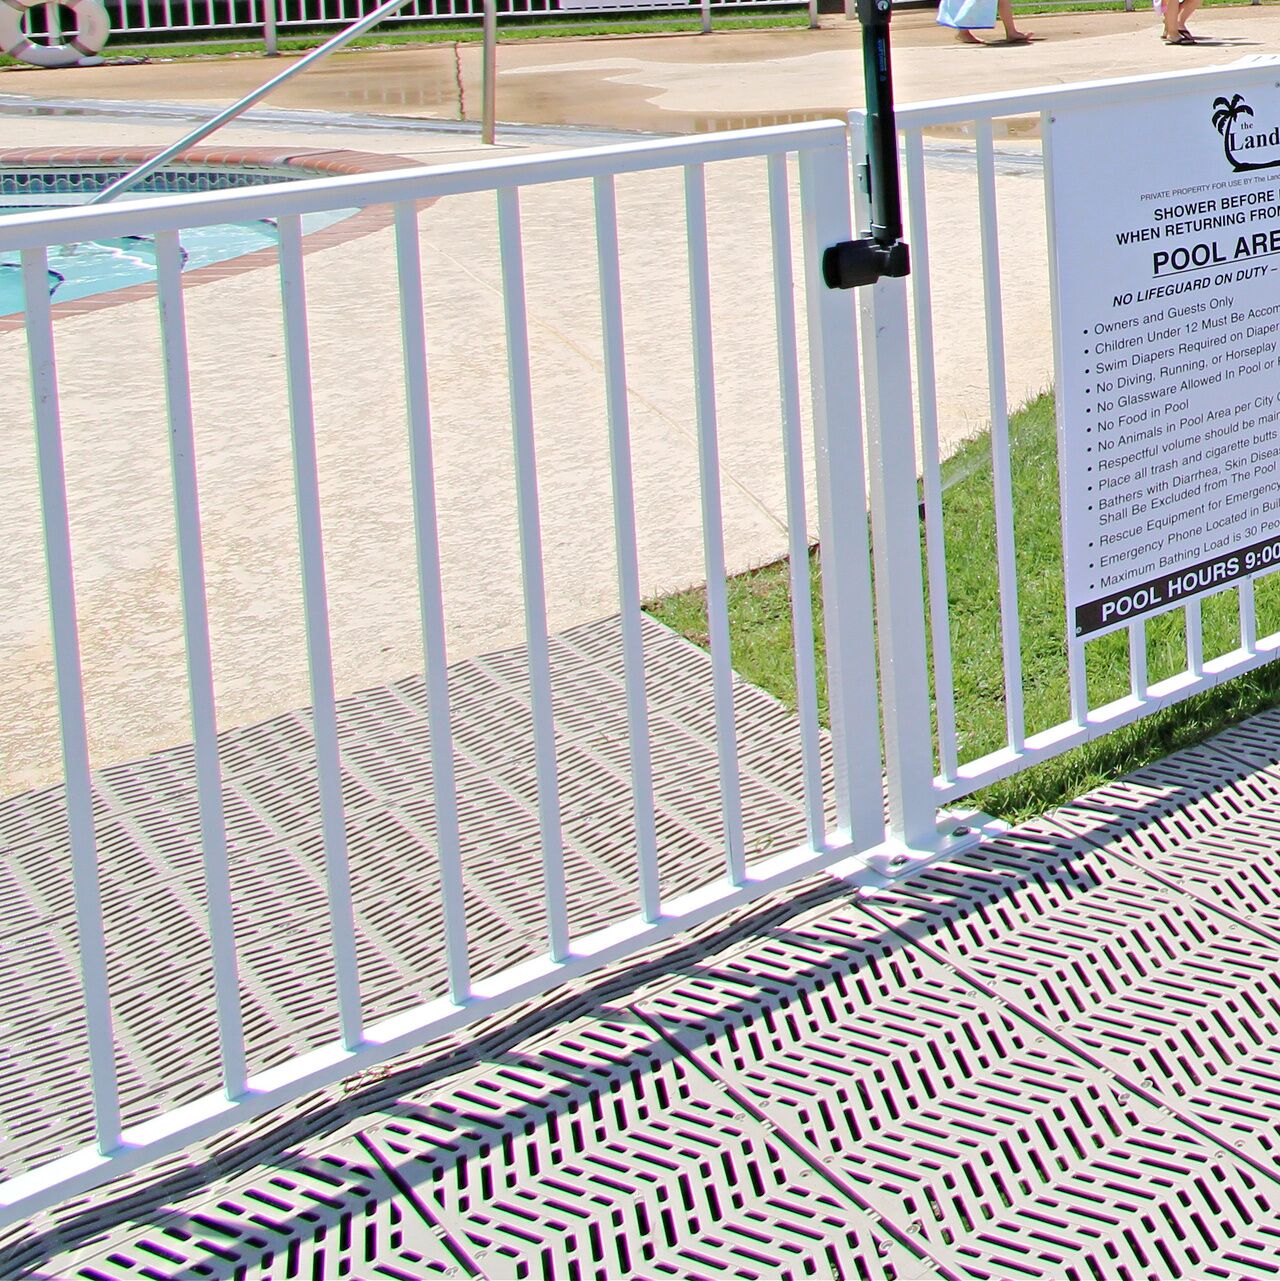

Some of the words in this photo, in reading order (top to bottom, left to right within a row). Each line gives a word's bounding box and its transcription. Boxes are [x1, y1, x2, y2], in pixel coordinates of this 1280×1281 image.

[1240, 122, 1254, 130] the
[1140, 190, 1170, 201] PRIVATE
[1172, 183, 1210, 196] PROPERTY
[1211, 181, 1226, 189] FOR
[1227, 178, 1242, 188] USE
[1243, 177, 1252, 185] BY
[1154, 200, 1216, 221] SHOWER
[1221, 189, 1275, 210] BEFORE
[1115, 226, 1160, 245] WHEN
[1165, 211, 1245, 237] RETURNING
[1153, 241, 1226, 274] POOL
[1112, 293, 1132, 307] NO
[1137, 277, 1211, 302] LIFEGUARD
[1214, 272, 1232, 286] ON
[1236, 265, 1268, 281] DUTY
[1094, 317, 1139, 335] Owners
[1142, 309, 1164, 325] and
[1167, 303, 1206, 318] Guests
[1209, 296, 1234, 309] Only
[1095, 336, 1143, 354] Children
[1147, 327, 1181, 342] Under
[1185, 321, 1198, 333] 12
[1201, 315, 1227, 330] Must
[1230, 312, 1245, 323] Be
[1096, 359, 1127, 374] Swim
[1131, 348, 1175, 366] Diapers
[1178, 333, 1226, 354] Required
[1230, 331, 1243, 342] on
[1246, 322, 1279, 338] Diaper
[1096, 381, 1113, 394] No
[1117, 372, 1155, 389] Diving,
[1160, 359, 1208, 378] Running,
[1211, 354, 1222, 365] or
[1225, 341, 1276, 361] Horseplay
[1097, 400, 1113, 413] No
[1117, 385, 1177, 407] Glassware
[1179, 371, 1221, 391] Allowed
[1225, 369, 1234, 380] In
[1238, 361, 1261, 376] Pool
[1263, 359, 1274, 369] or
[1097, 420, 1114, 432] No
[1118, 409, 1147, 427] Food
[1151, 407, 1160, 418] in
[1164, 398, 1188, 414] Pool
[1098, 439, 1114, 452] No
[1117, 426, 1163, 447] Animals
[1166, 422, 1176, 433] in
[1179, 413, 1203, 429] Pool
[1206, 408, 1231, 421] Area
[1234, 402, 1251, 416] per
[1254, 396, 1274, 408] City
[1098, 444, 1158, 471] Respectful
[1162, 434, 1201, 452] volume
[1204, 421, 1239, 441] should
[1242, 419, 1255, 430] be
[1098, 474, 1131, 491] Place
[1134, 466, 1147, 480] all
[1151, 458, 1178, 475] trash
[1181, 450, 1202, 466] and
[1205, 438, 1250, 459] cigarette
[1253, 430, 1277, 444] butts
[1098, 489, 1143, 510] Bathers
[1146, 480, 1168, 495] with
[1172, 466, 1221, 487] Diarrhea,
[1225, 456, 1247, 471] Skin
[1099, 507, 1127, 526] Shall
[1131, 503, 1147, 515] Be
[1151, 484, 1201, 509] Excluded
[1204, 478, 1227, 492] from
[1230, 471, 1250, 483] The
[1254, 460, 1276, 476] Pool
[1099, 525, 1143, 547] Rescue
[1146, 504, 1205, 531] Equipment
[1208, 499, 1222, 511] for
[1100, 539, 1164, 567] Emergency
[1167, 526, 1202, 544] Phone
[1206, 509, 1247, 532] Located
[1250, 506, 1259, 517] in
[1100, 562, 1155, 588] Maximum
[1159, 547, 1200, 568] Bathing
[1203, 534, 1229, 552] Load
[1233, 532, 1241, 542] is
[1244, 525, 1257, 538] 30
[1102, 586, 1162, 622] POOL
[1168, 557, 1239, 598] HOURS
